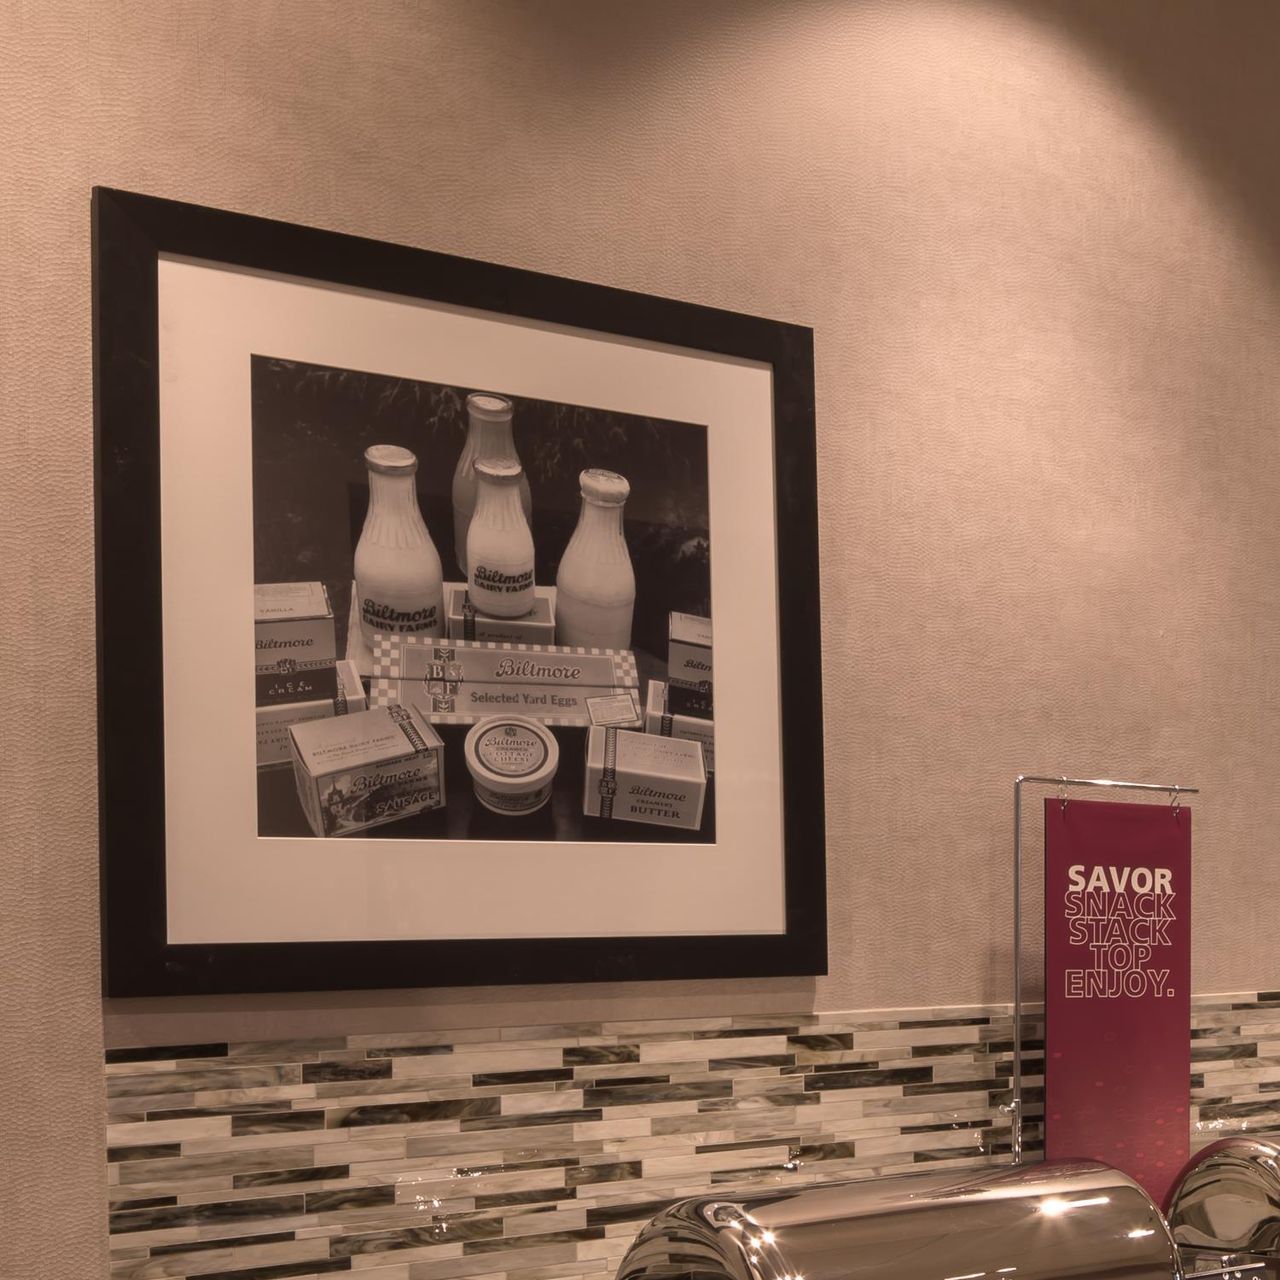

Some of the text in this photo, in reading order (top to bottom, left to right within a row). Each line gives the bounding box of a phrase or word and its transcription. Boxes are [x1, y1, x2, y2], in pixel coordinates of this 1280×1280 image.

[362, 598, 438, 622] Biltmore
[362, 614, 439, 633] DAIRY FARMS
[255, 636, 315, 651] Biltmore
[495, 657, 582, 681] Biltmore
[267, 685, 314, 696] CREAM
[470, 691, 520, 706] Selected
[522, 692, 547, 706] Yard
[550, 693, 578, 708] Eggs
[485, 736, 538, 747] Biltmore
[350, 767, 422, 794] Biltmore
[376, 791, 436, 814] SAUSAGE
[628, 785, 688, 802] Biltmore
[629, 804, 681, 820] BUTTER
[1068, 864, 1174, 895] SAVOR
[1064, 890, 1177, 920] SNACK
[1069, 916, 1173, 946] STACK
[1089, 942, 1152, 972] TOP
[1064, 968, 1175, 998] ENJOY.
